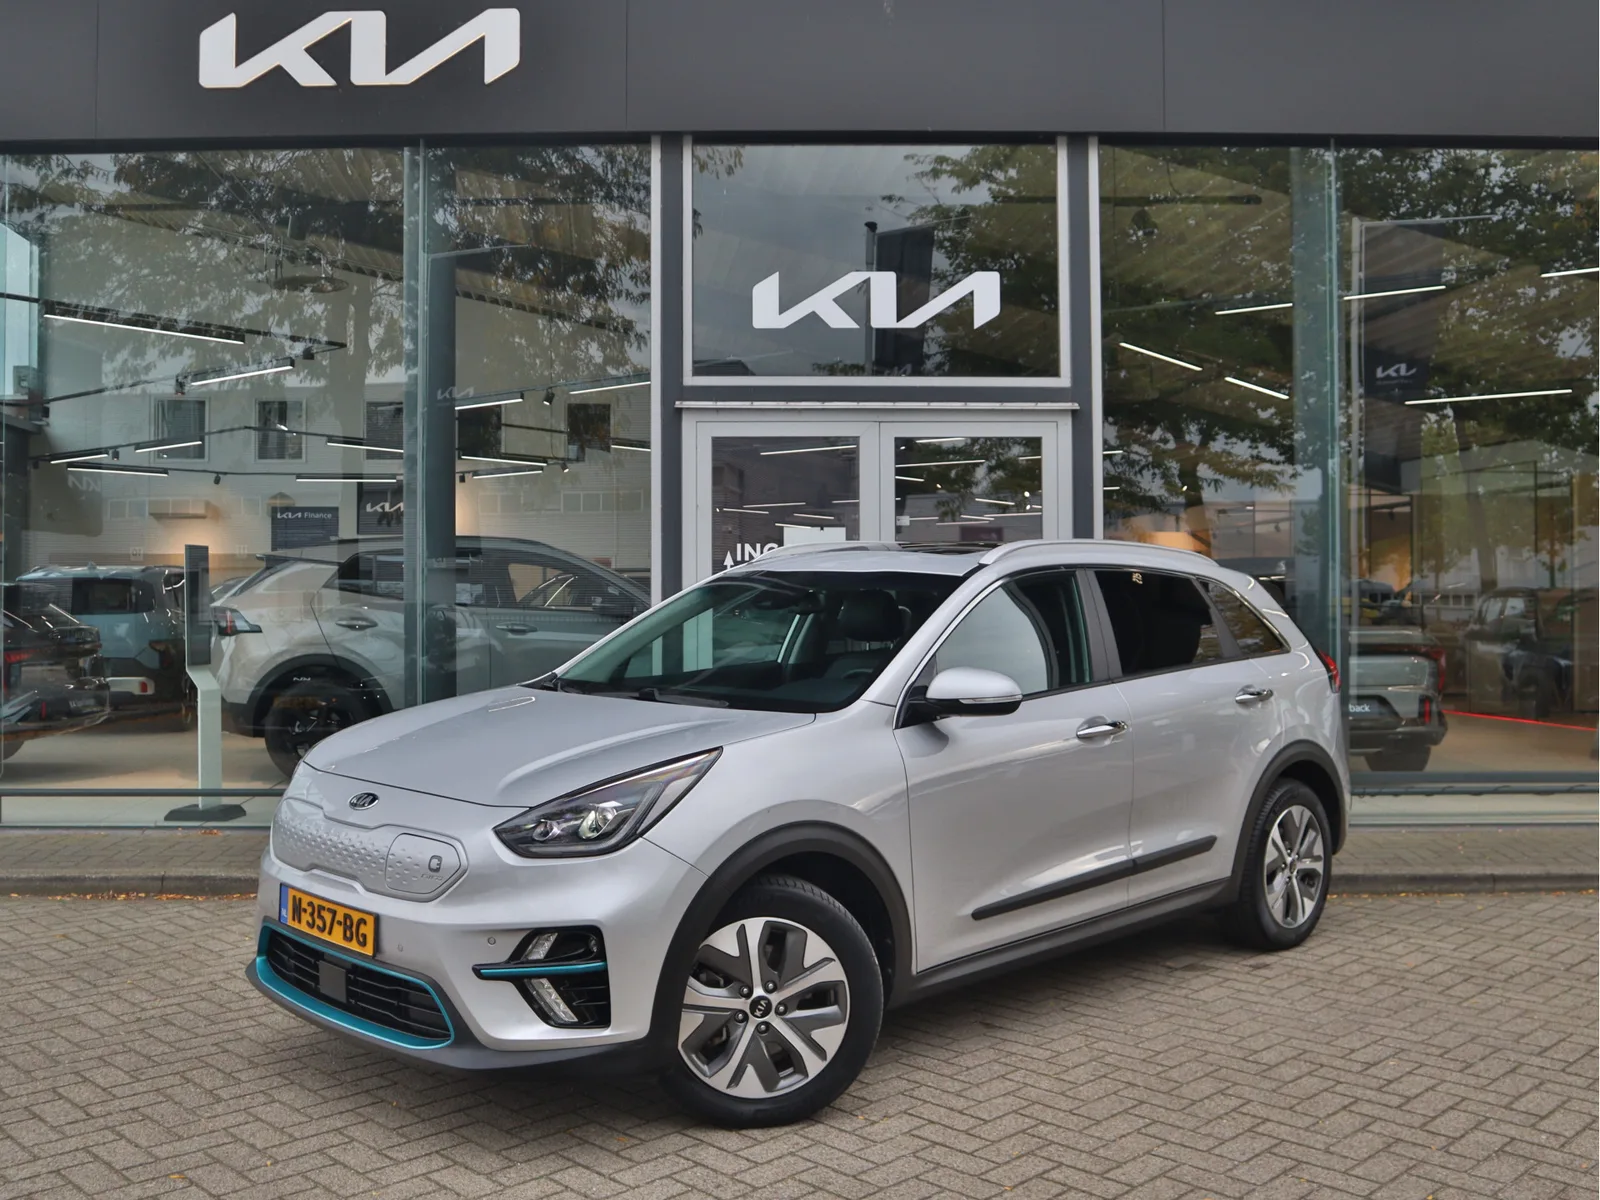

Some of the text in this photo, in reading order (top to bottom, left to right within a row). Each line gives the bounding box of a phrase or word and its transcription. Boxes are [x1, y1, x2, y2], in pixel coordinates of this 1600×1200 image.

[199, 8, 520, 89] KIA
[752, 271, 1001, 329] KIA
[350, 793, 375, 807] KIA
[292, 895, 367, 948] N-357-BG
[754, 1000, 768, 1017] KIA
